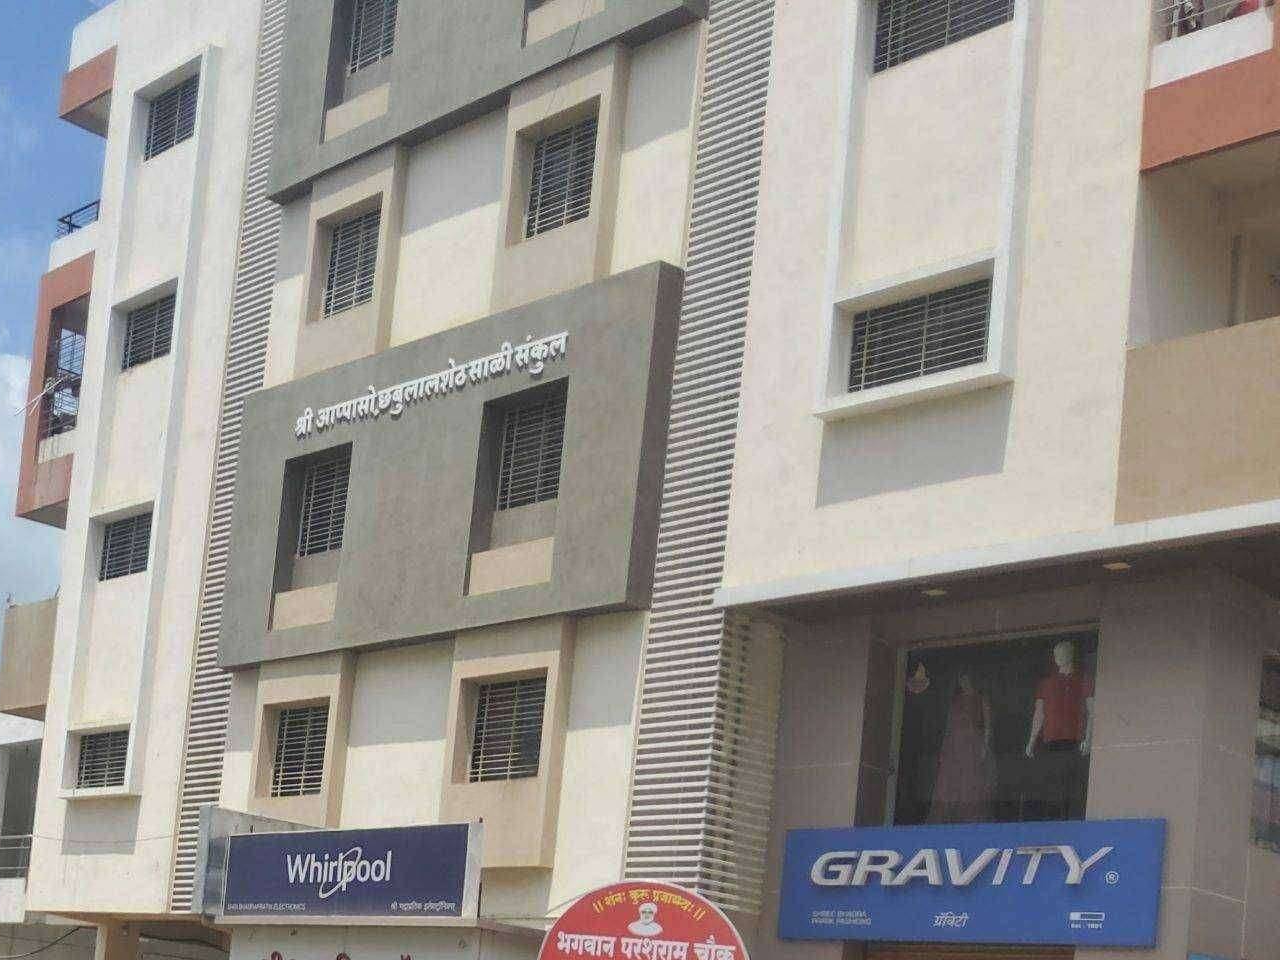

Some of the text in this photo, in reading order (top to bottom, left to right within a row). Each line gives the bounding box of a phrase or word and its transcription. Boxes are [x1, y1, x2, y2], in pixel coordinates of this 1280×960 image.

[286, 847, 392, 898] Whirlpool
[810, 846, 1114, 886] GRAVITY
[557, 931, 616, 958] भगवान
